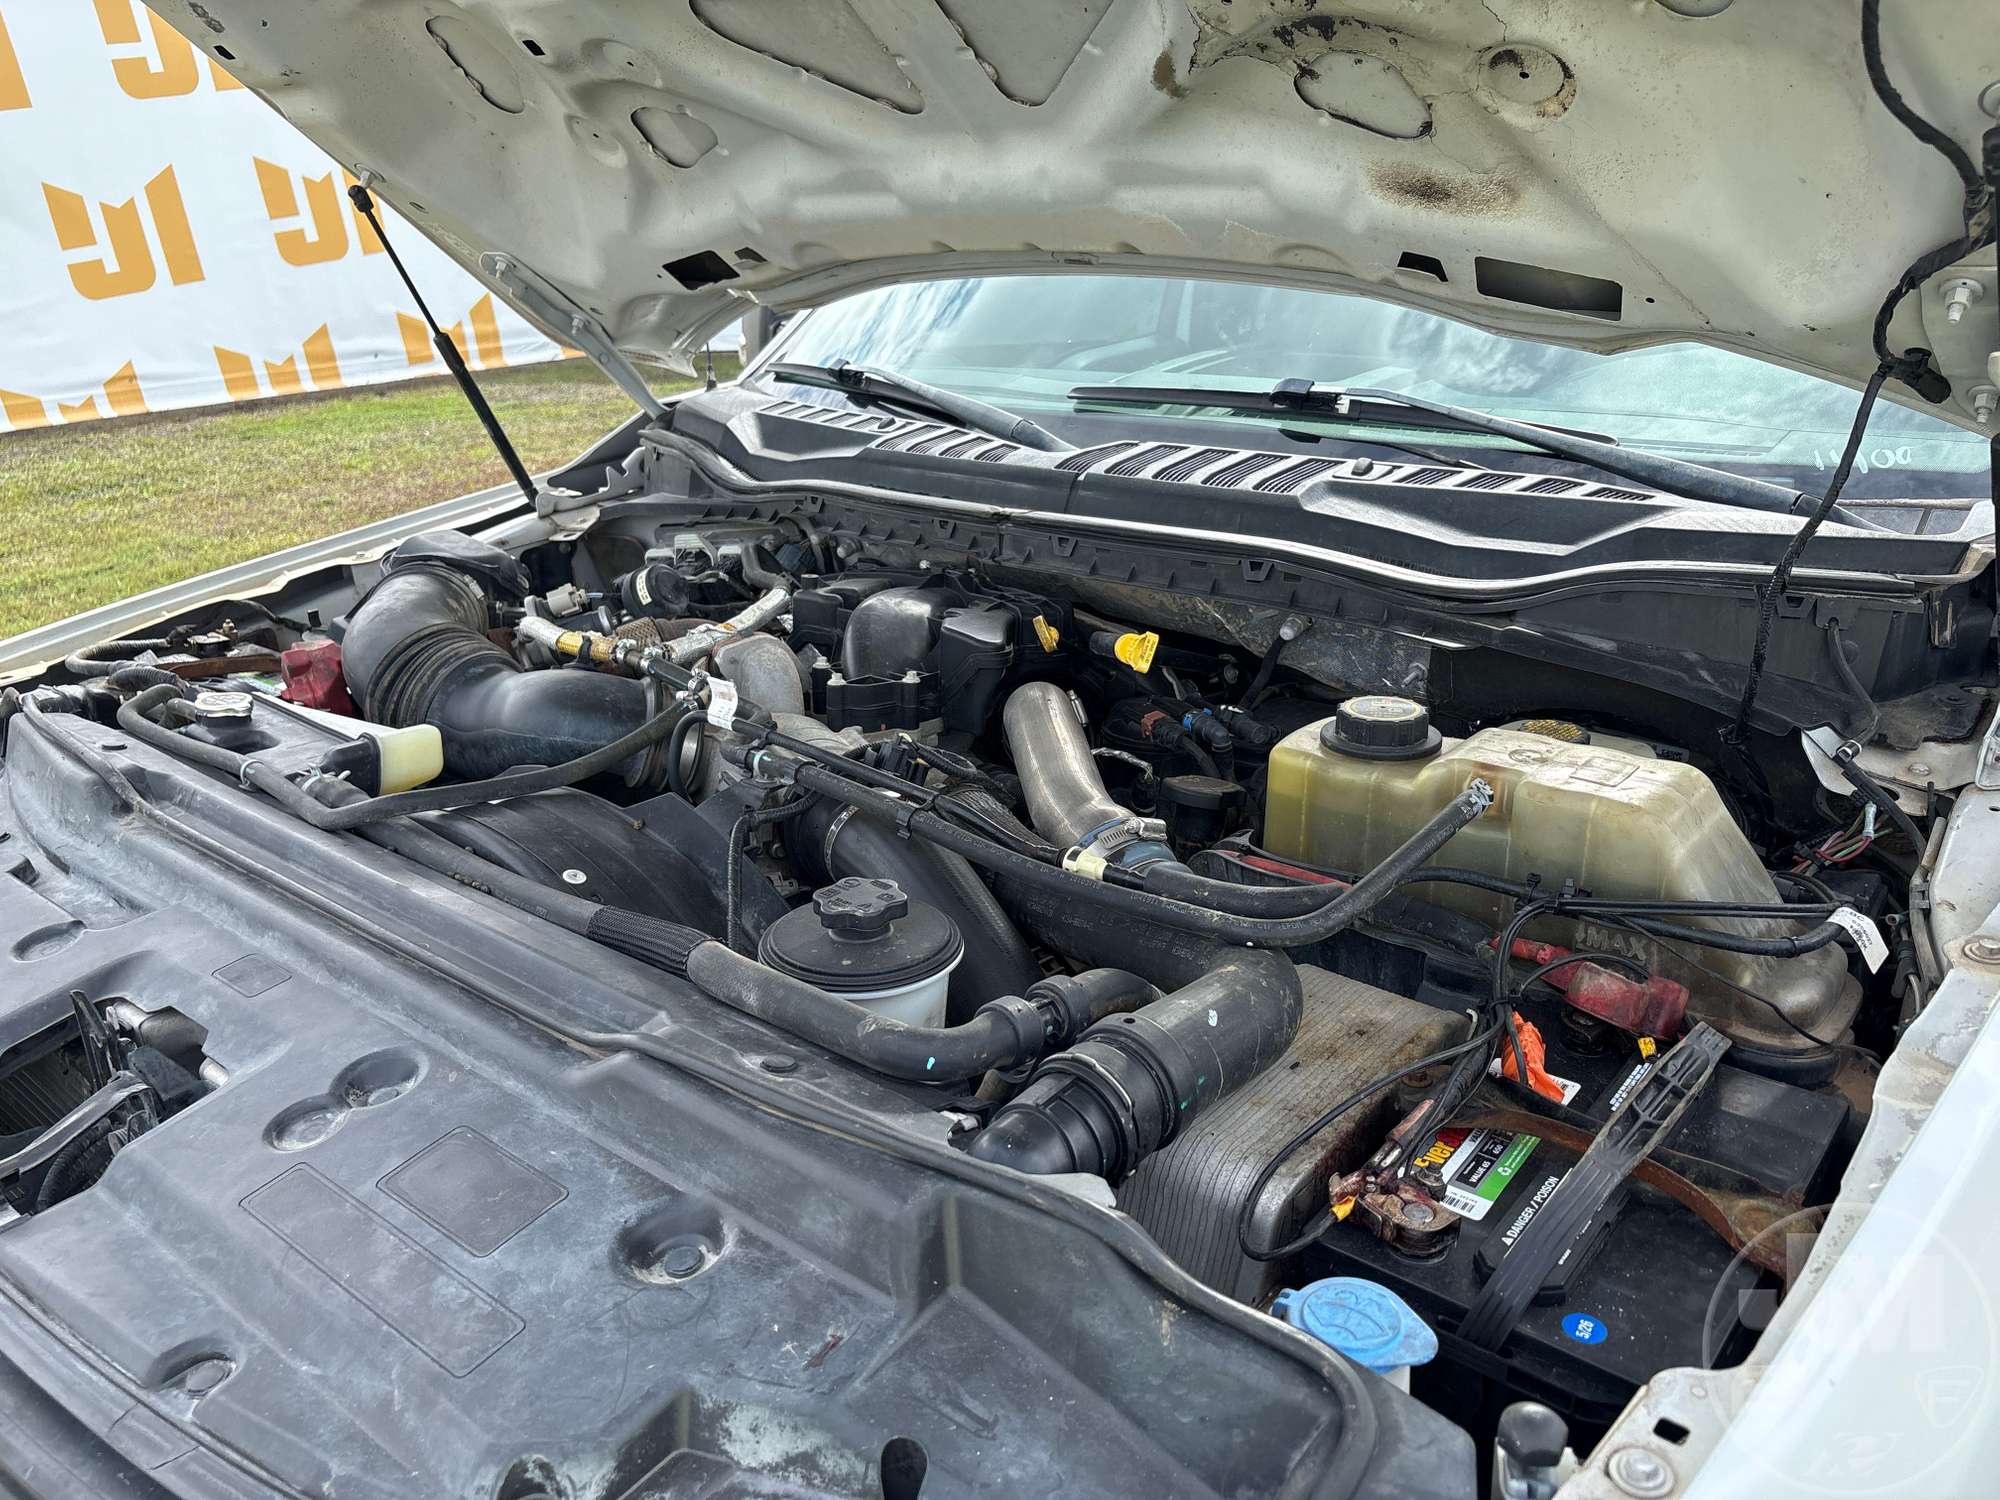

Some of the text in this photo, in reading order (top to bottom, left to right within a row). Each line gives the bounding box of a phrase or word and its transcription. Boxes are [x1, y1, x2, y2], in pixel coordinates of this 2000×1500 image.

[1587, 926, 1648, 961] MAX
[1506, 1206, 1536, 1239] DANGER
[1533, 1175, 1560, 1203] POISON
